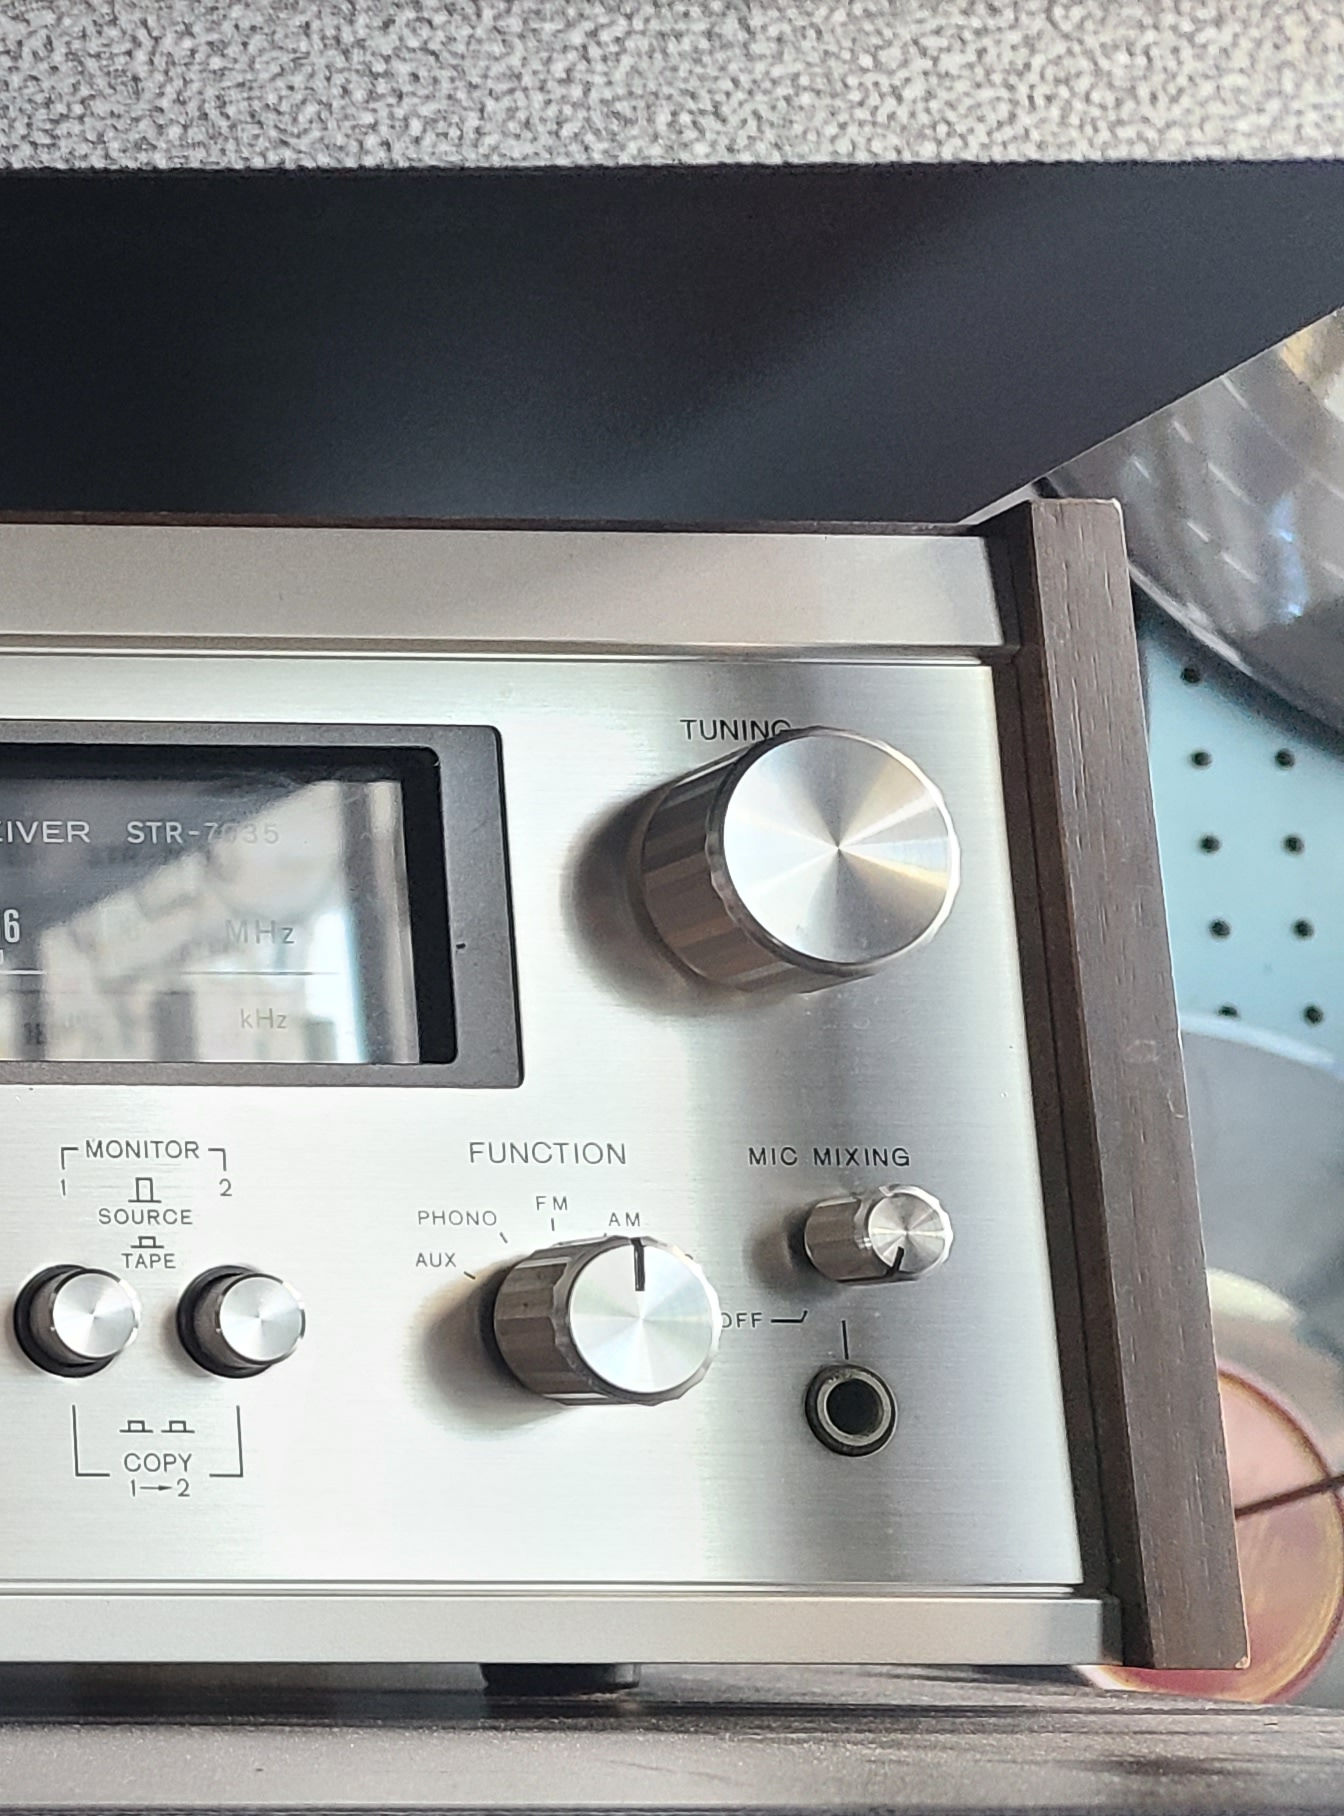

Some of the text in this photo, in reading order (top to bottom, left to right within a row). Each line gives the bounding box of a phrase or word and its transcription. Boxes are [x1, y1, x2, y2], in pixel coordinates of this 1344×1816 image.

[226, 919, 295, 945] MHz
[240, 1008, 288, 1030] kHz
[85, 1139, 200, 1159] MONITOR
[469, 1141, 626, 1165] FUNCTION
[748, 1146, 910, 1167] MIC MIXING
[218, 1178, 233, 1197] 2
[535, 1195, 568, 1211] FM
[98, 1207, 193, 1226] SOURCE
[417, 1209, 497, 1226] PHONO
[608, 1212, 641, 1227] AM
[120, 1252, 177, 1269] TAPE
[415, 1252, 457, 1268] AUX
[123, 1452, 192, 1473] COPY
